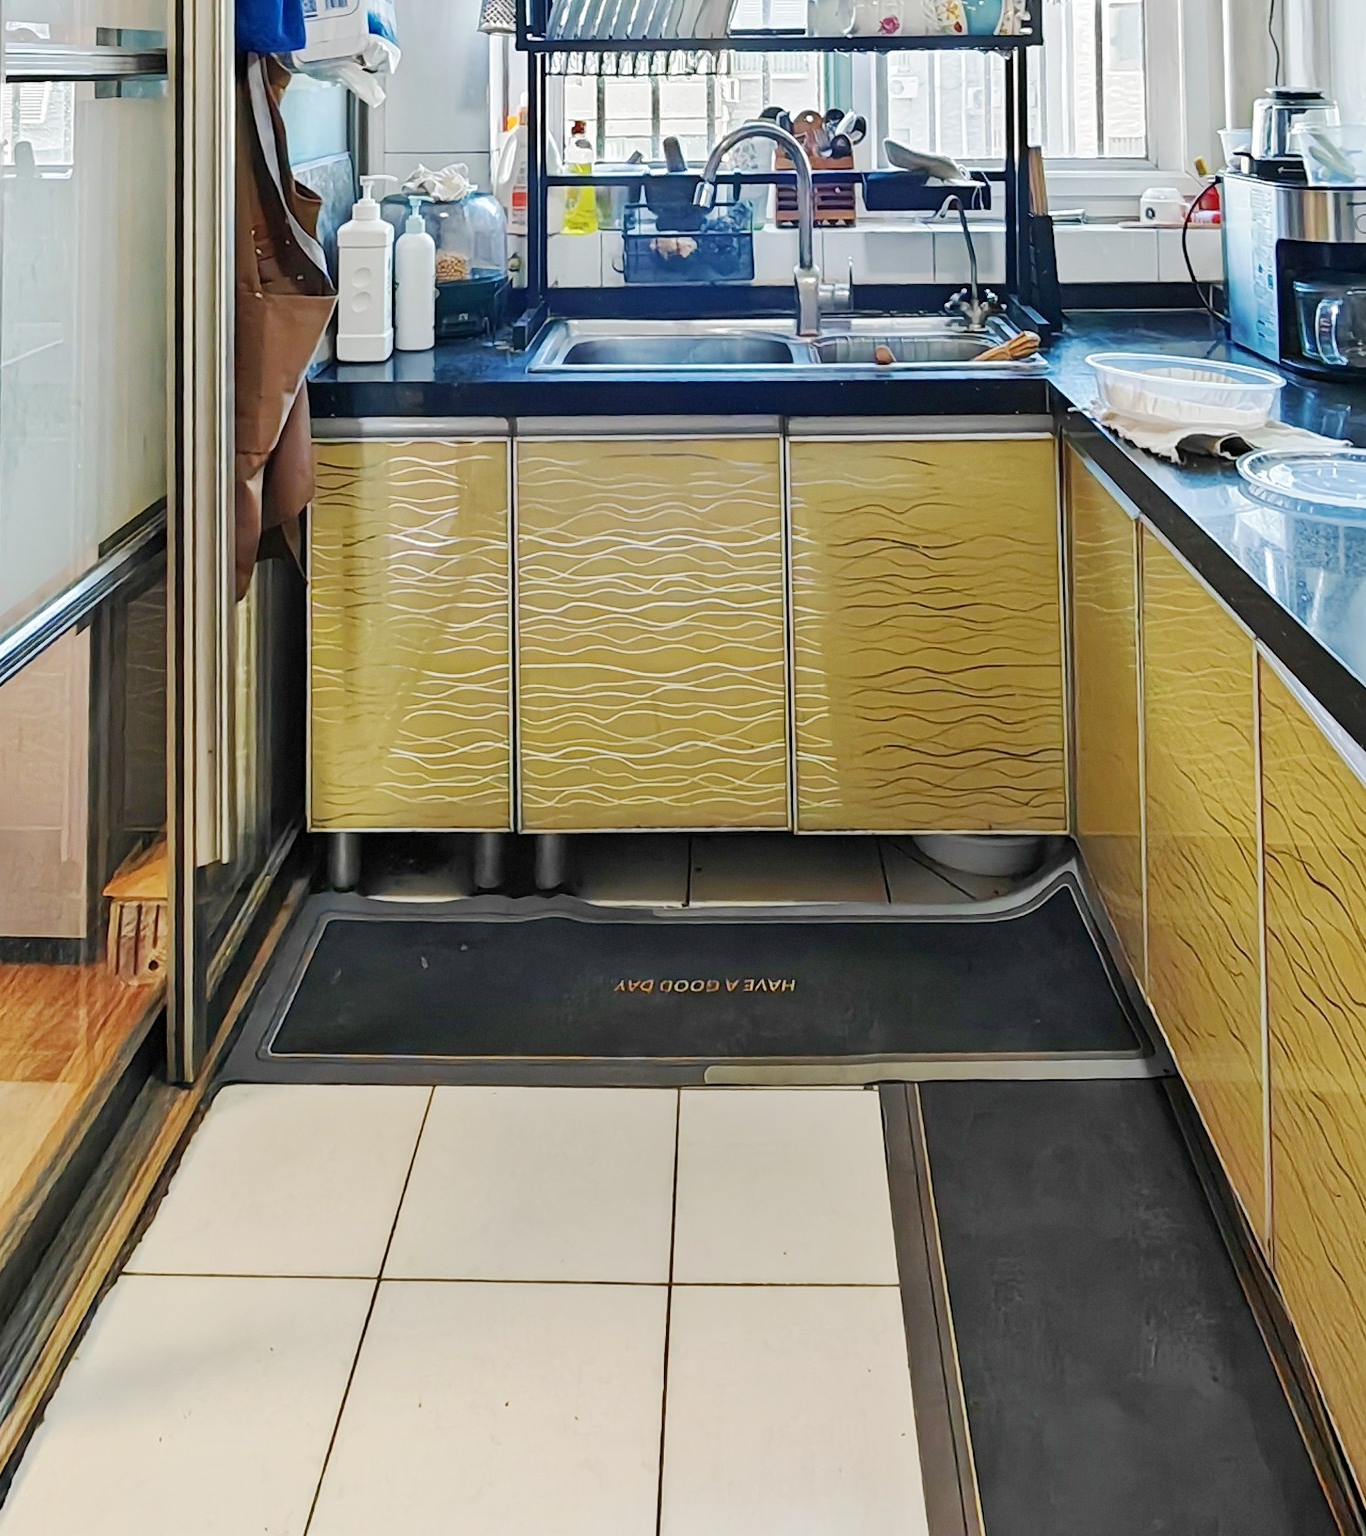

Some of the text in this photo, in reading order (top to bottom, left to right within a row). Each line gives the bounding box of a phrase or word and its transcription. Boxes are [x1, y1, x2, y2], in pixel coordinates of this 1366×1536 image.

[613, 978, 796, 994] HAVE A GOOD DAY
